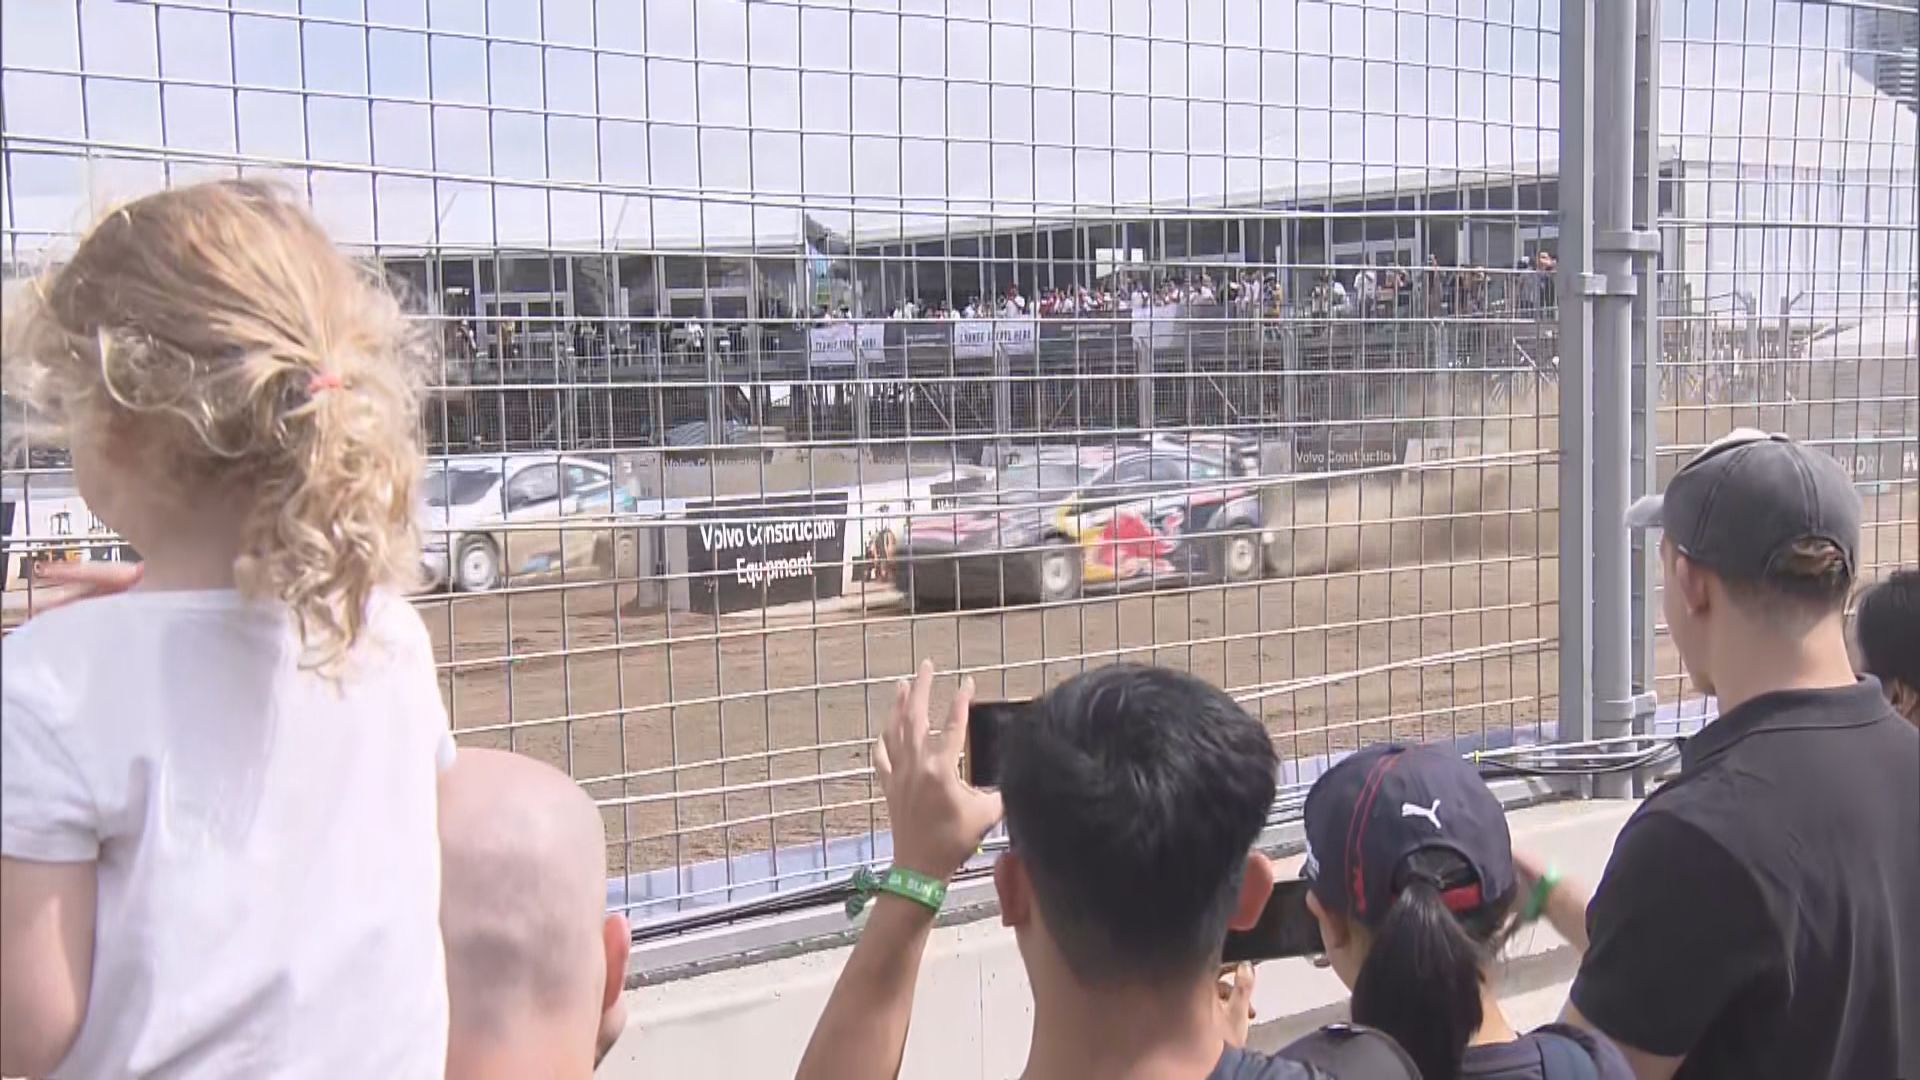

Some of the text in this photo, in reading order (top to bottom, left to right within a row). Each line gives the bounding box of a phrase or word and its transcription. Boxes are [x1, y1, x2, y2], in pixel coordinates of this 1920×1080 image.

[1296, 449, 1325, 464] Volvo
[700, 523, 744, 551] Volvo
[736, 550, 812, 589] Equpment
